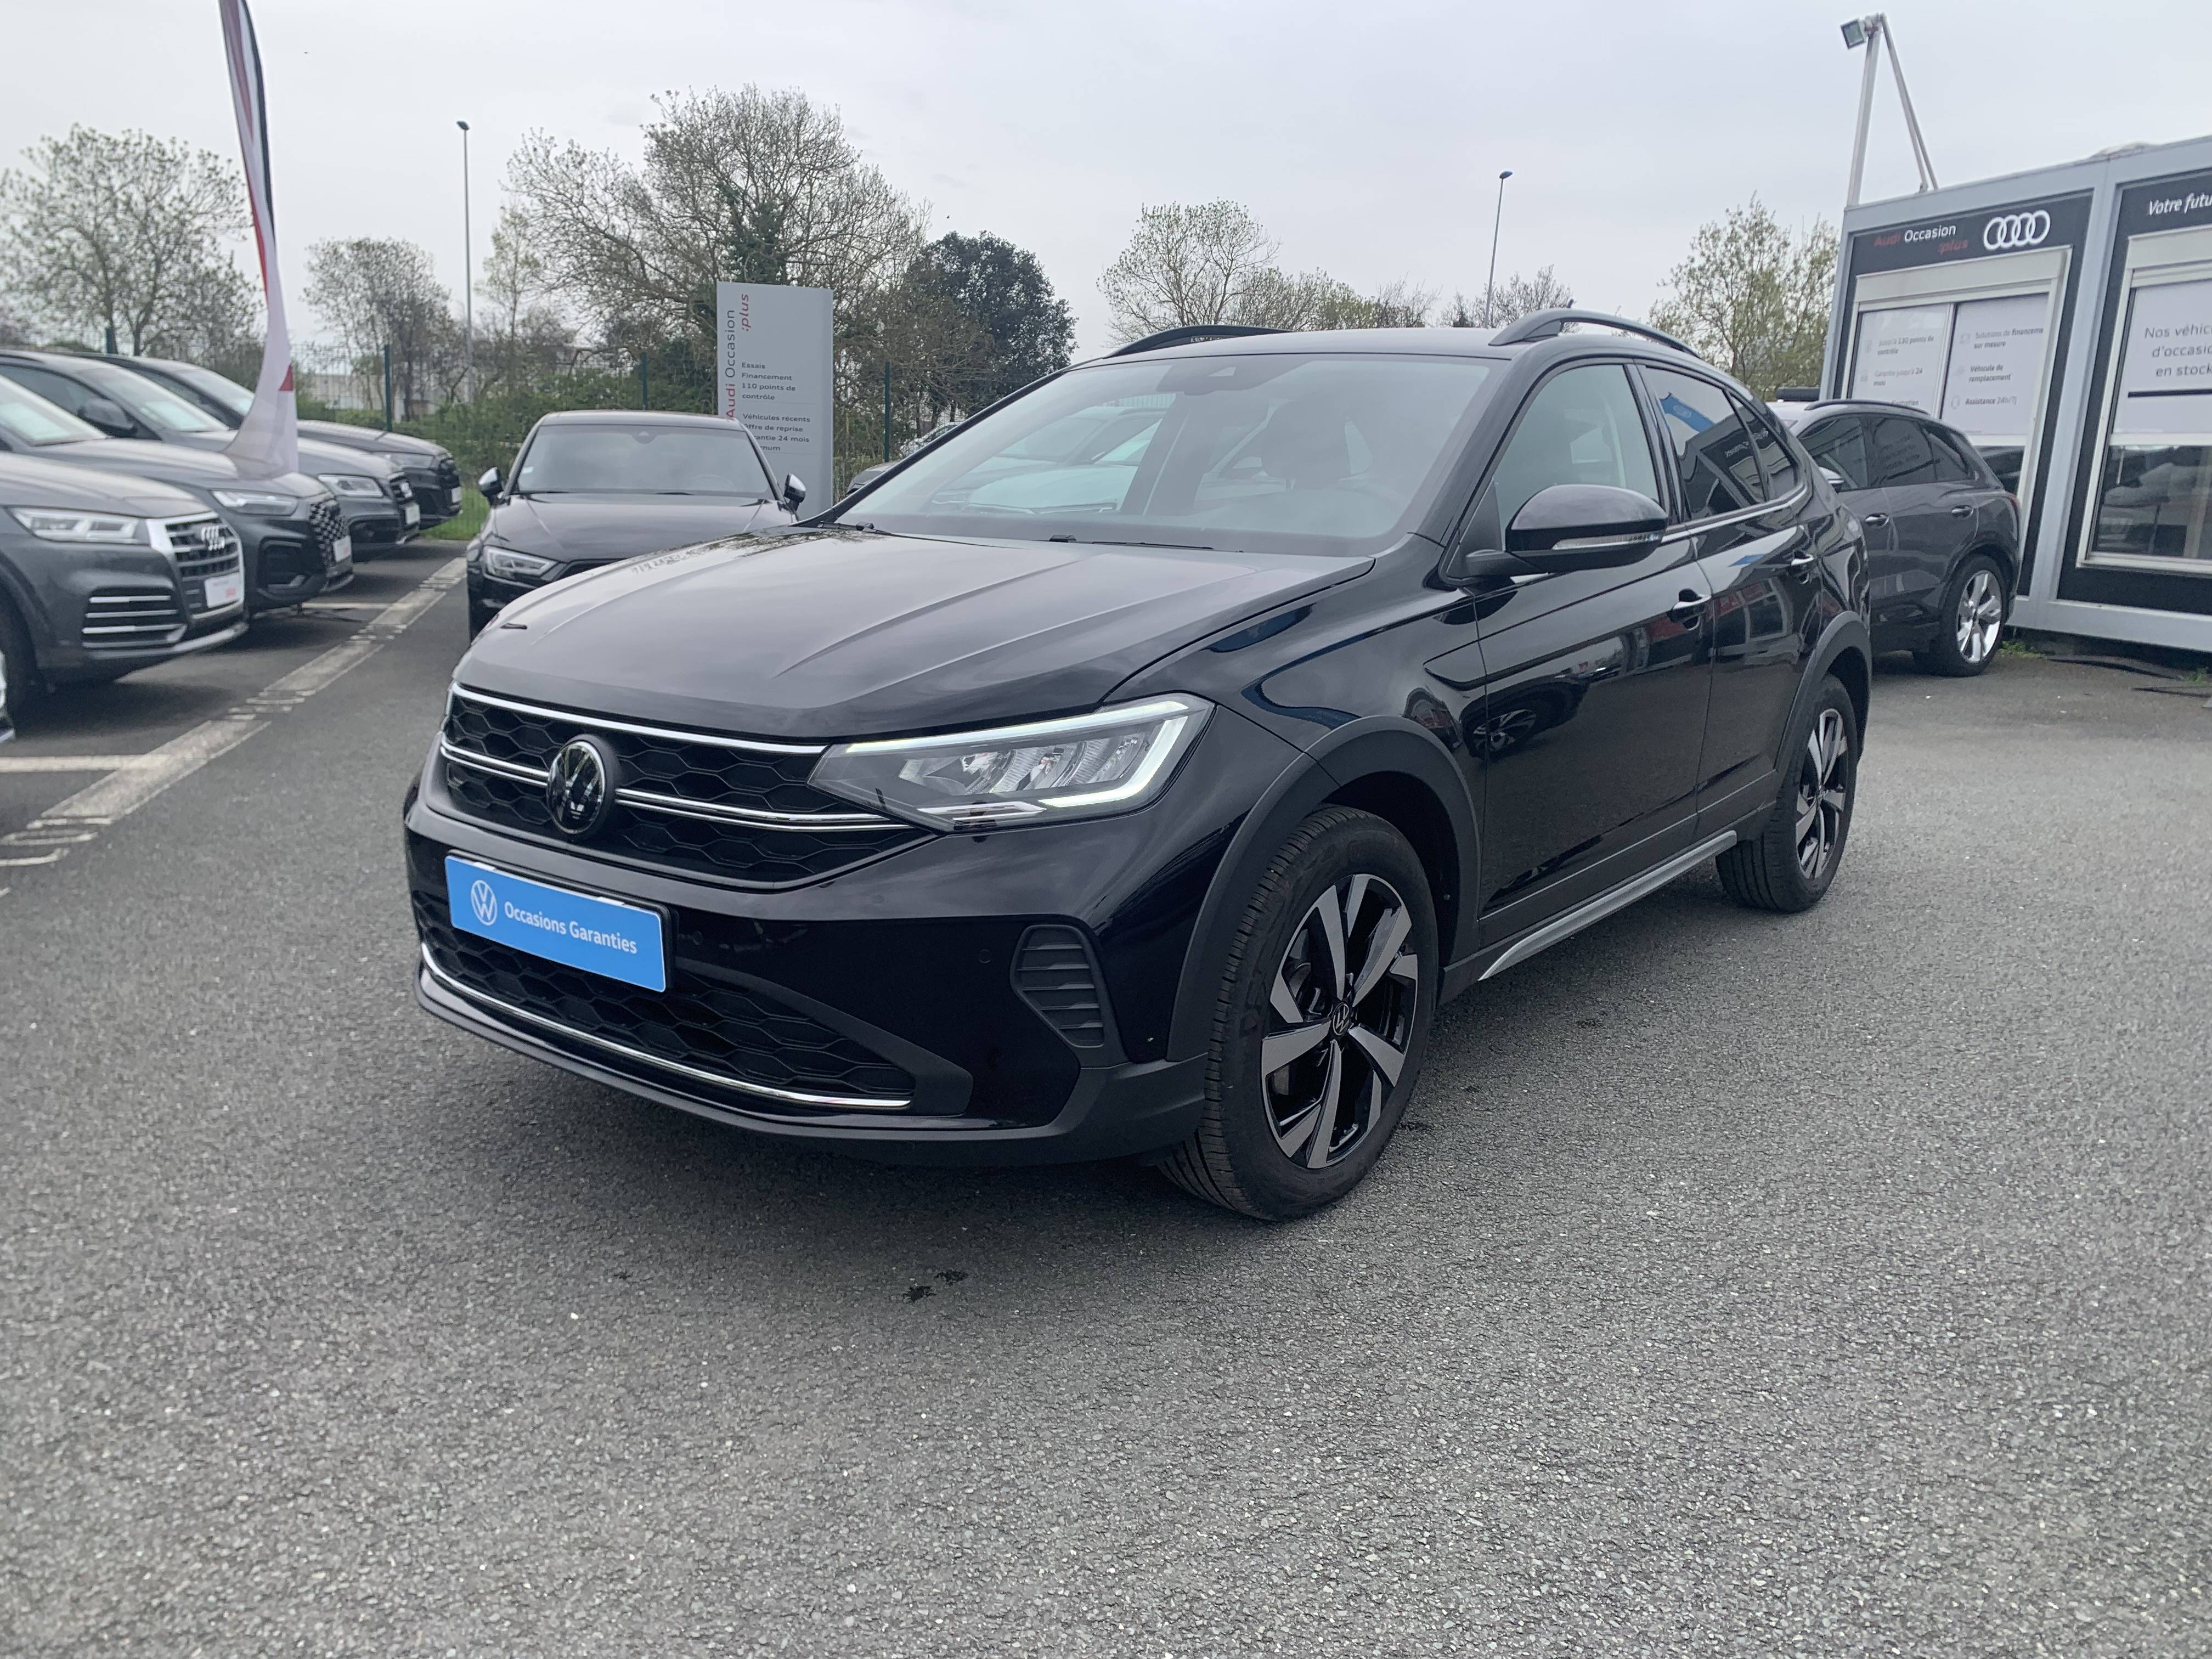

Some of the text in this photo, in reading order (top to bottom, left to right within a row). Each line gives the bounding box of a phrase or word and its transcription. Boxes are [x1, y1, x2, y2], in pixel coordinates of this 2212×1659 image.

[2149, 192, 2212, 216] Votre futu
[1874, 225, 1956, 246] Audi Occasion
[2145, 323, 2212, 338] Nos véhic
[1984, 341, 2006, 349] mesure
[725, 309, 736, 420] Audi Occasion
[1970, 363, 2004, 373] Véhicule de
[2155, 363, 2212, 377] en stock
[741, 372, 793, 381] Financement
[504, 901, 567, 935] Occasions
[569, 920, 637, 954] Garanties
